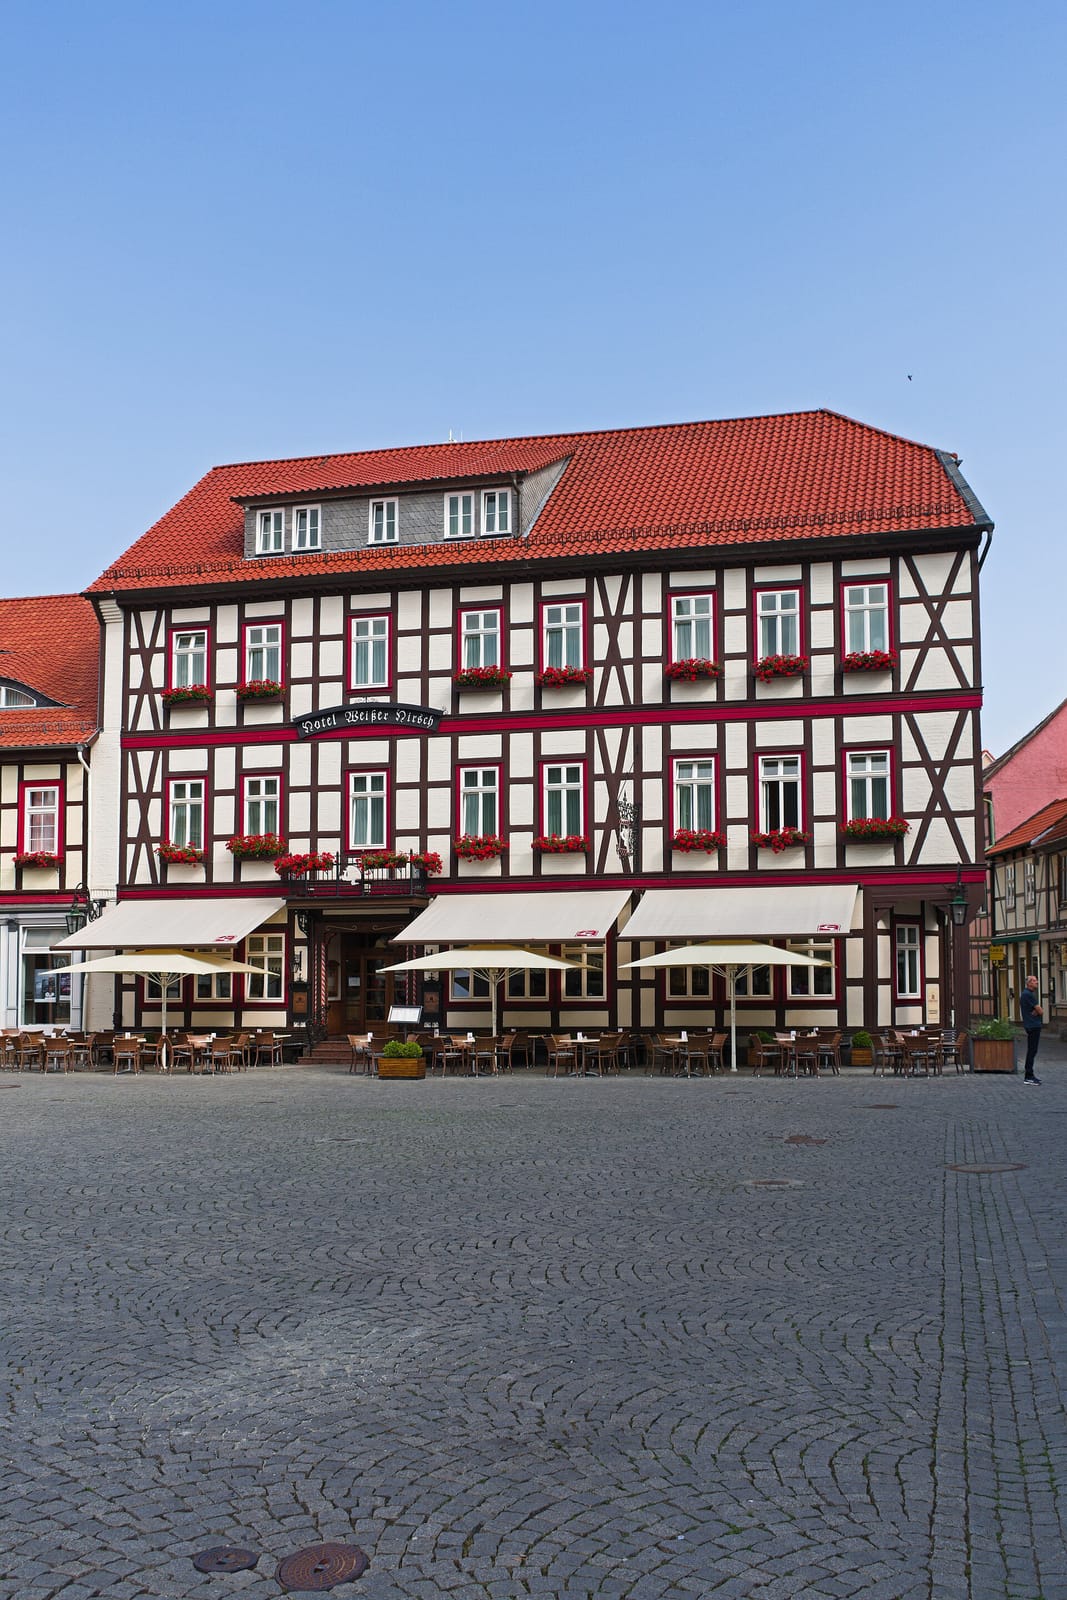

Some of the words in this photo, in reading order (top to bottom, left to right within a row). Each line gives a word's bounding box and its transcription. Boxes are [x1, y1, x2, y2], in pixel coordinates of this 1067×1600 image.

[302, 714, 336, 733] Hotel
[345, 709, 388, 723] Weißer
[396, 709, 434, 728] Hirsch
